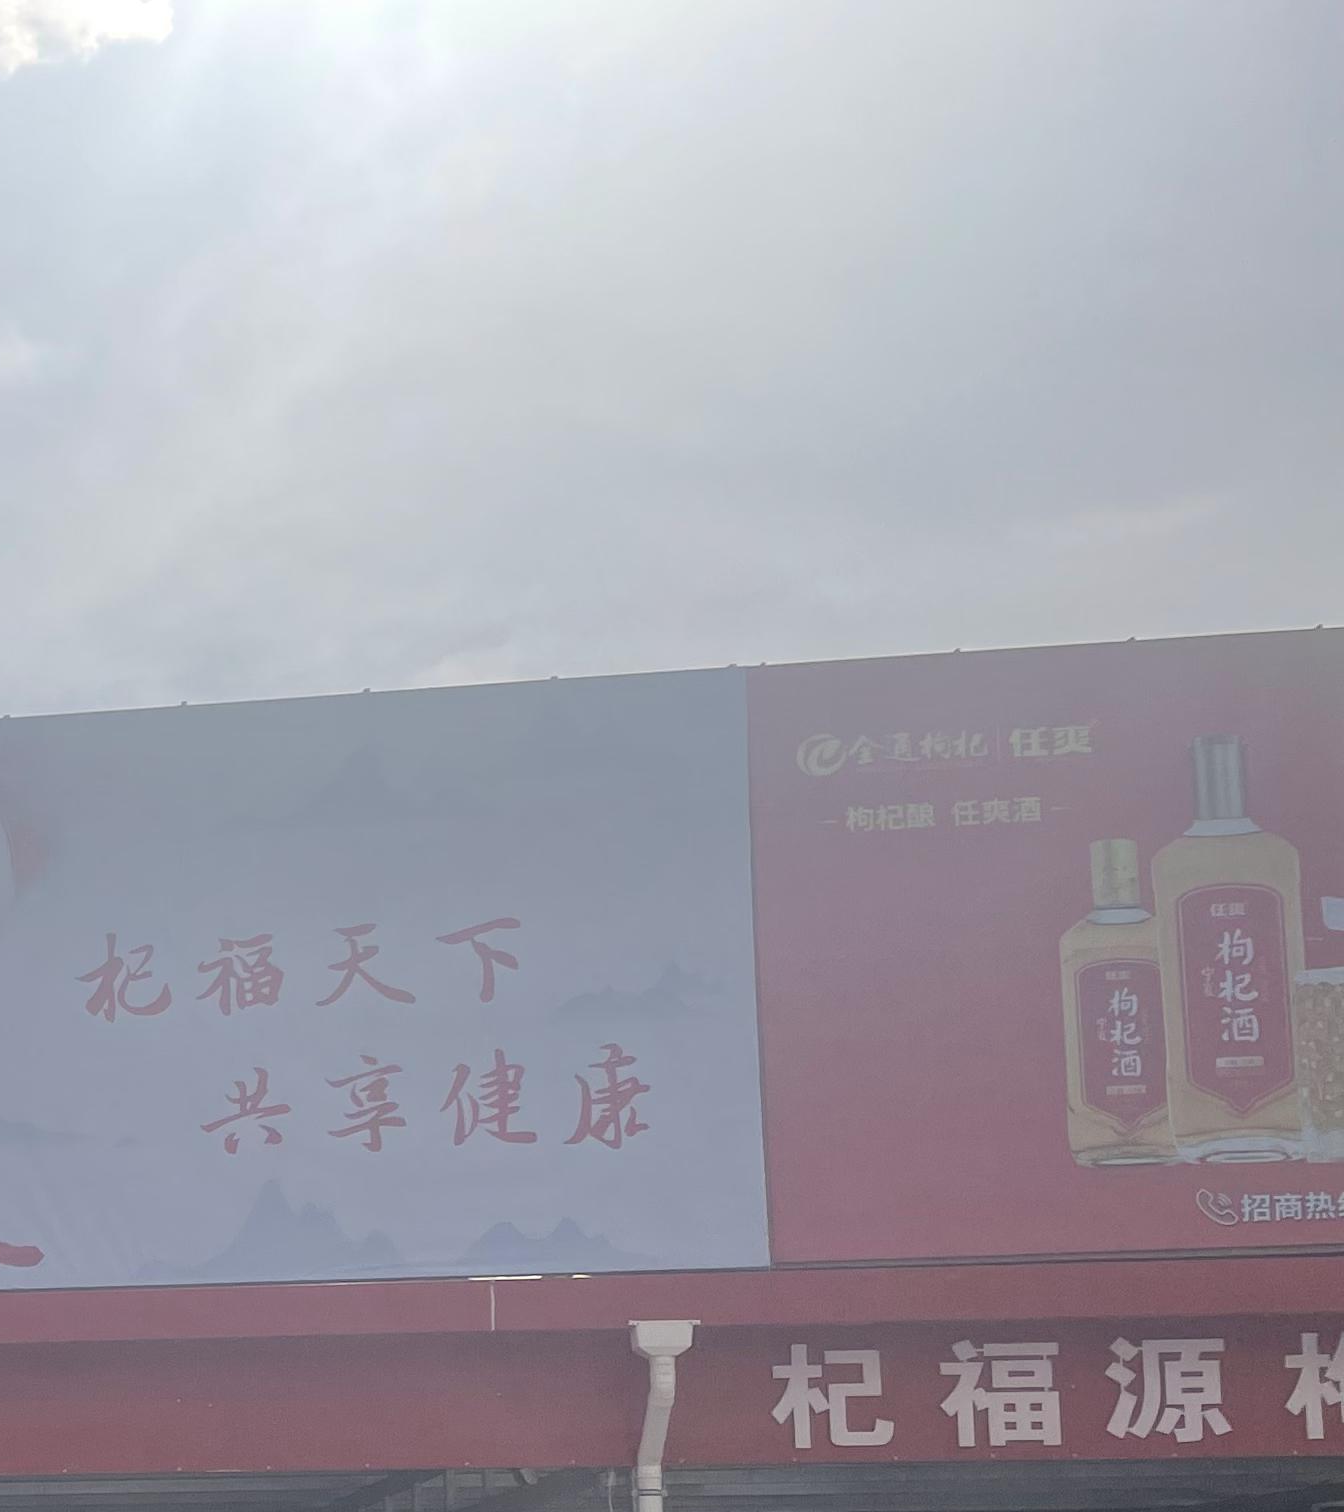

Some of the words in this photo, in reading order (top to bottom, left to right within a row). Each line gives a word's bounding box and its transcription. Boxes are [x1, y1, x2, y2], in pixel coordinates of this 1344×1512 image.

[1008, 725, 1093, 758] 任爽
[950, 796, 1042, 827] 任爽酒
[74, 916, 521, 1024] 杞福天下
[1214, 928, 1260, 1043] 枸杞酒
[1107, 987, 1142, 1077] 枸杞酒
[200, 1043, 650, 1155] 共享健康
[1240, 1191, 1344, 1223] 招商热
